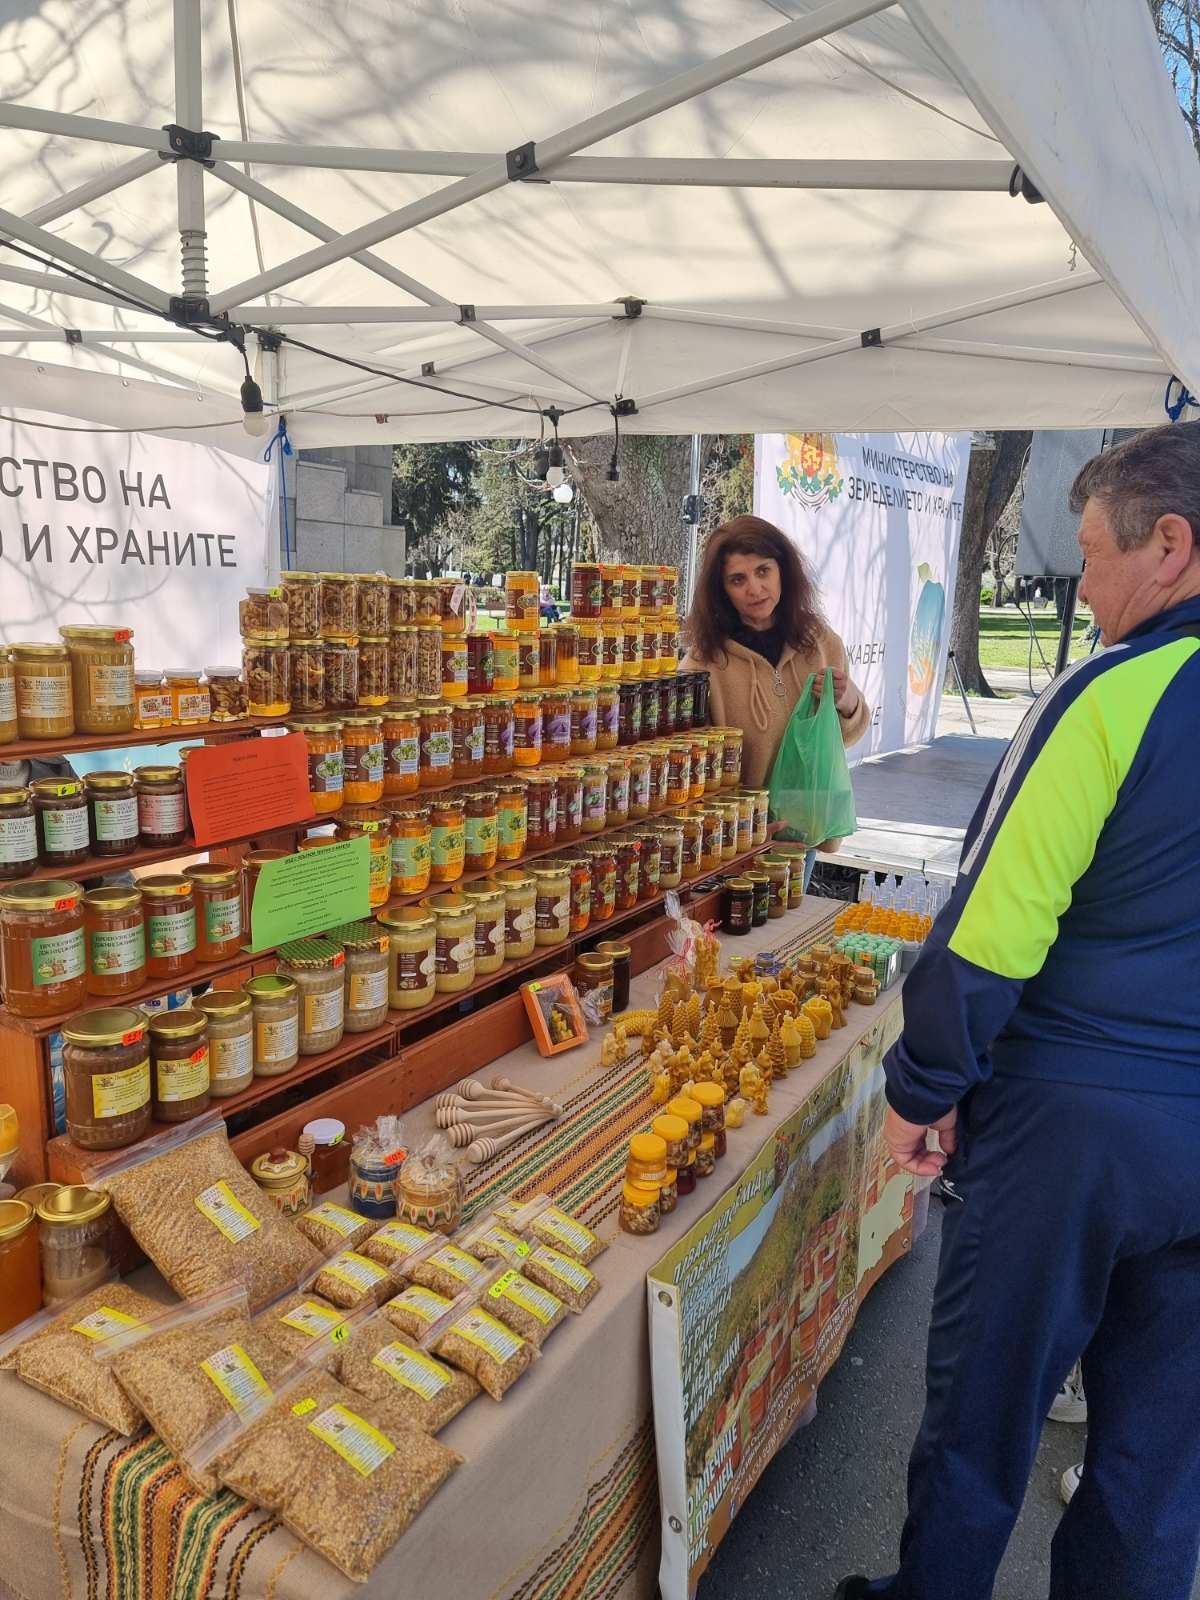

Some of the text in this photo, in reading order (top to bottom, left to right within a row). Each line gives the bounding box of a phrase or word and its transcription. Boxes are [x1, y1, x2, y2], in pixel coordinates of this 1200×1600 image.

[862, 446, 940, 485] МИНИСТЕРСТВО
[119, 469, 171, 509] НА
[848, 476, 922, 512] ЗЕМЕДЕЛИЕТО
[22, 523, 53, 563] И
[67, 525, 237, 568] ХРАНИТЕ
[691, 1358, 711, 1404] МЕД
[695, 1421, 738, 1506] МЛЕЧИЦЕ
[696, 1458, 735, 1534] ПРАШЕЦ
